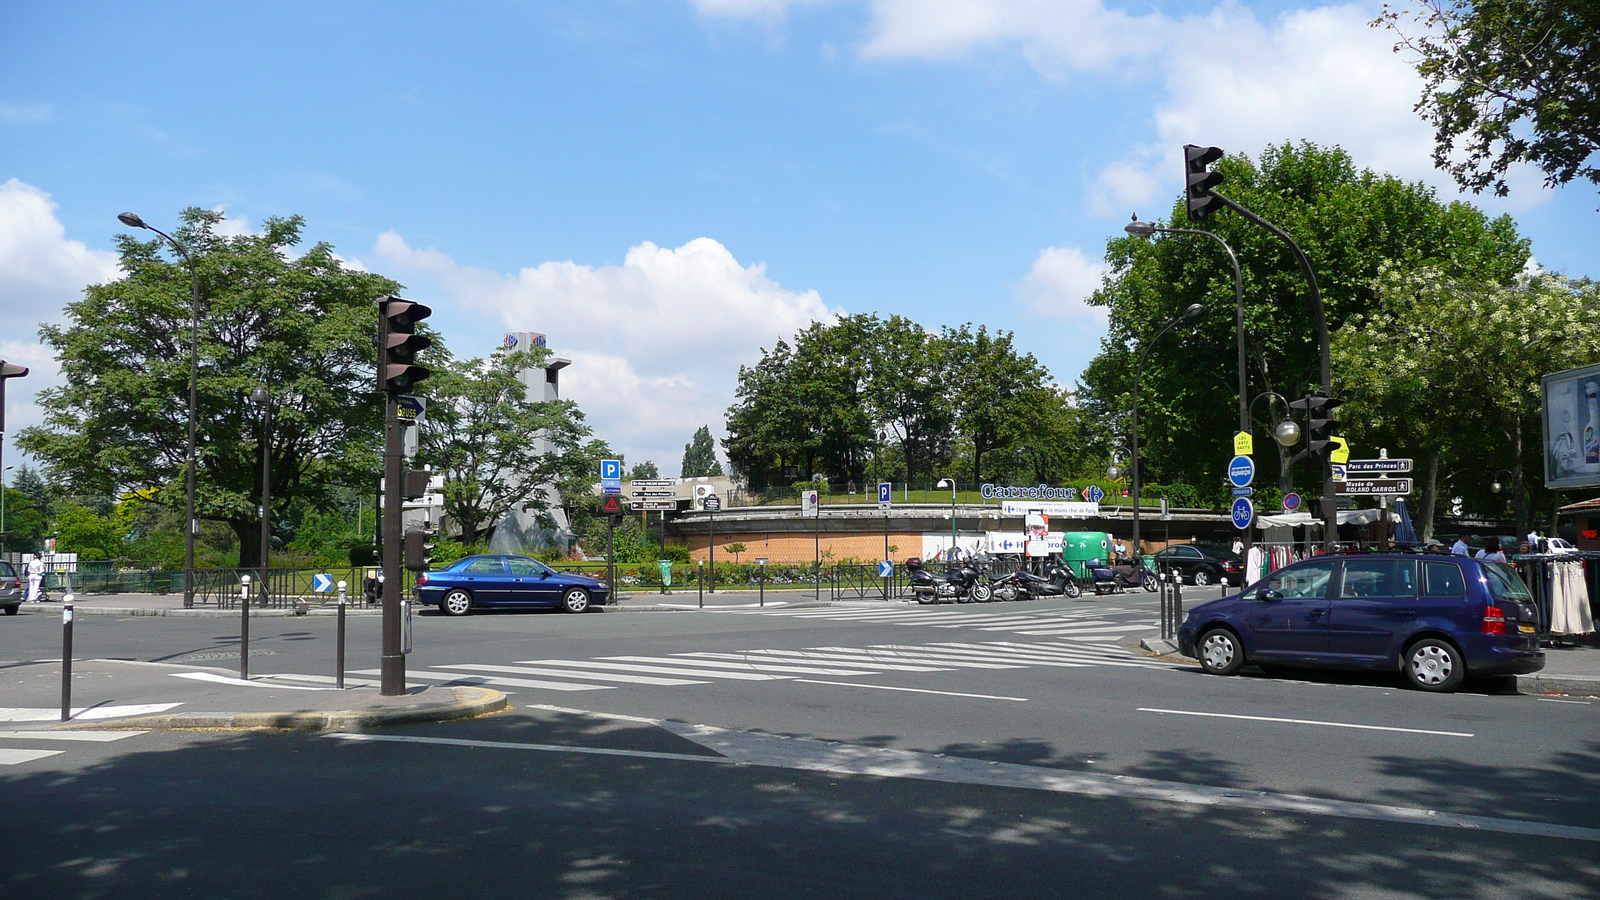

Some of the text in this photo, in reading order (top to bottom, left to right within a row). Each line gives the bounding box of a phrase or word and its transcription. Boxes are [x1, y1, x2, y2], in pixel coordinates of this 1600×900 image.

[608, 464, 616, 476] P
[881, 486, 888, 499] P
[982, 484, 1076, 499] Carrefour
